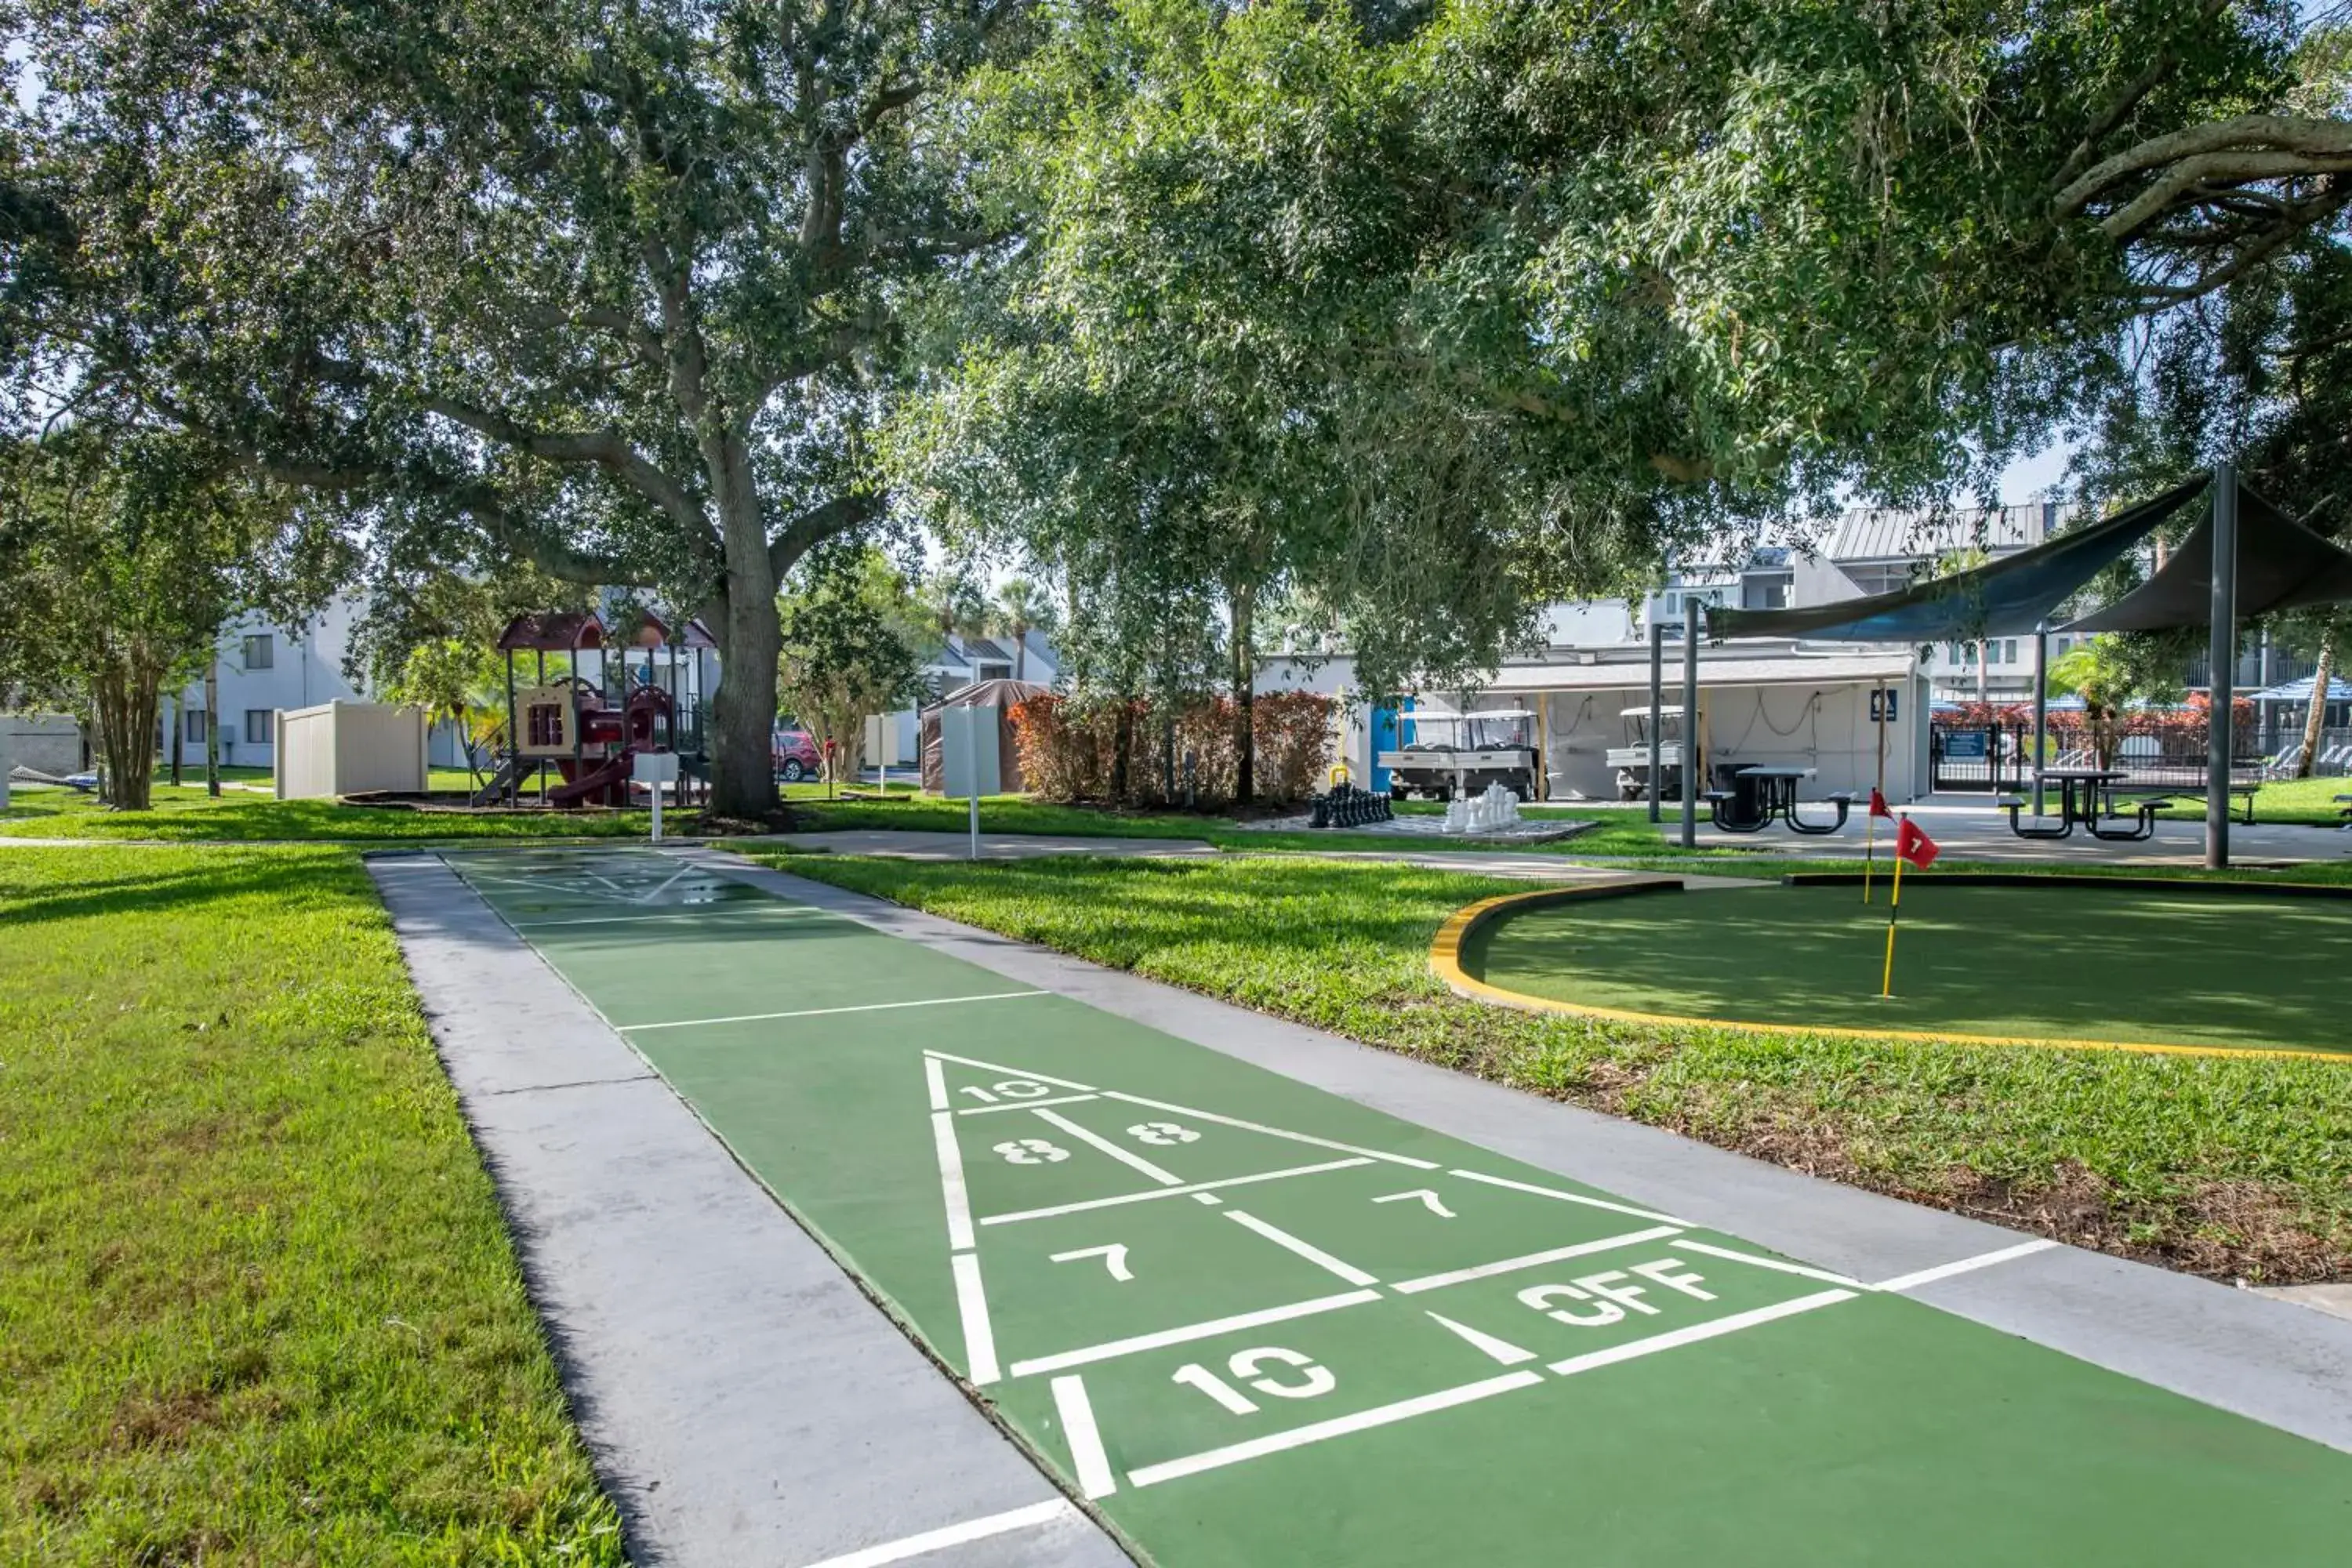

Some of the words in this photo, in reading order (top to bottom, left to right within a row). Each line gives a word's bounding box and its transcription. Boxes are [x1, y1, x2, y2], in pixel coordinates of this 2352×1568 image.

[959, 1080, 1051, 1102] 10
[1127, 1122, 1201, 1145] 8
[992, 1138, 1070, 1165] 8
[1371, 1189, 1457, 1218] 7
[1049, 1242, 1134, 1282] 7
[1516, 1258, 1719, 1327] OFF
[1171, 1346, 1336, 1415] 10
